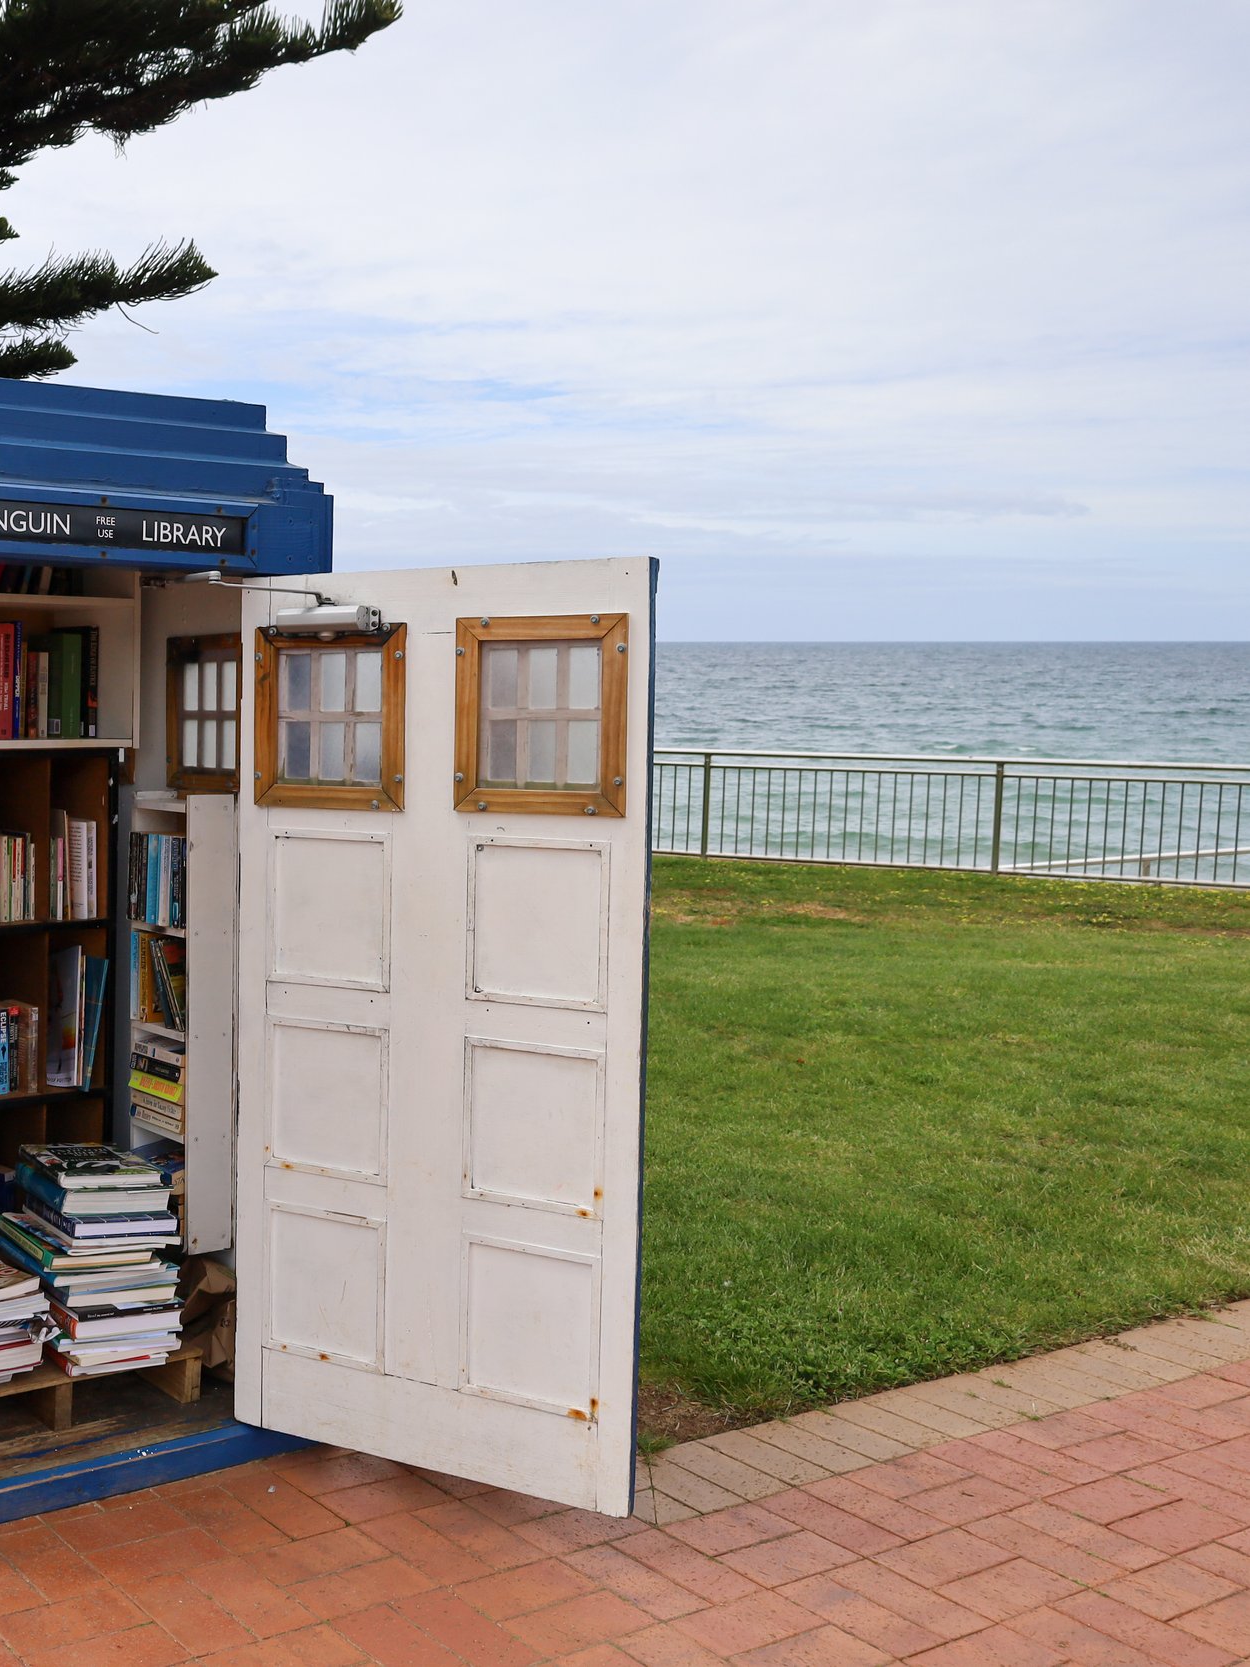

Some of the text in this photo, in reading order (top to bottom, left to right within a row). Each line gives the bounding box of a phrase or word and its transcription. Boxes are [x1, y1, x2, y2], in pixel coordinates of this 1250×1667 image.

[95, 516, 116, 527] FREE
[97, 528, 114, 539] USE
[141, 520, 227, 548] LIBRARY
[0, 1011, 7, 1043] ECLIPSE
